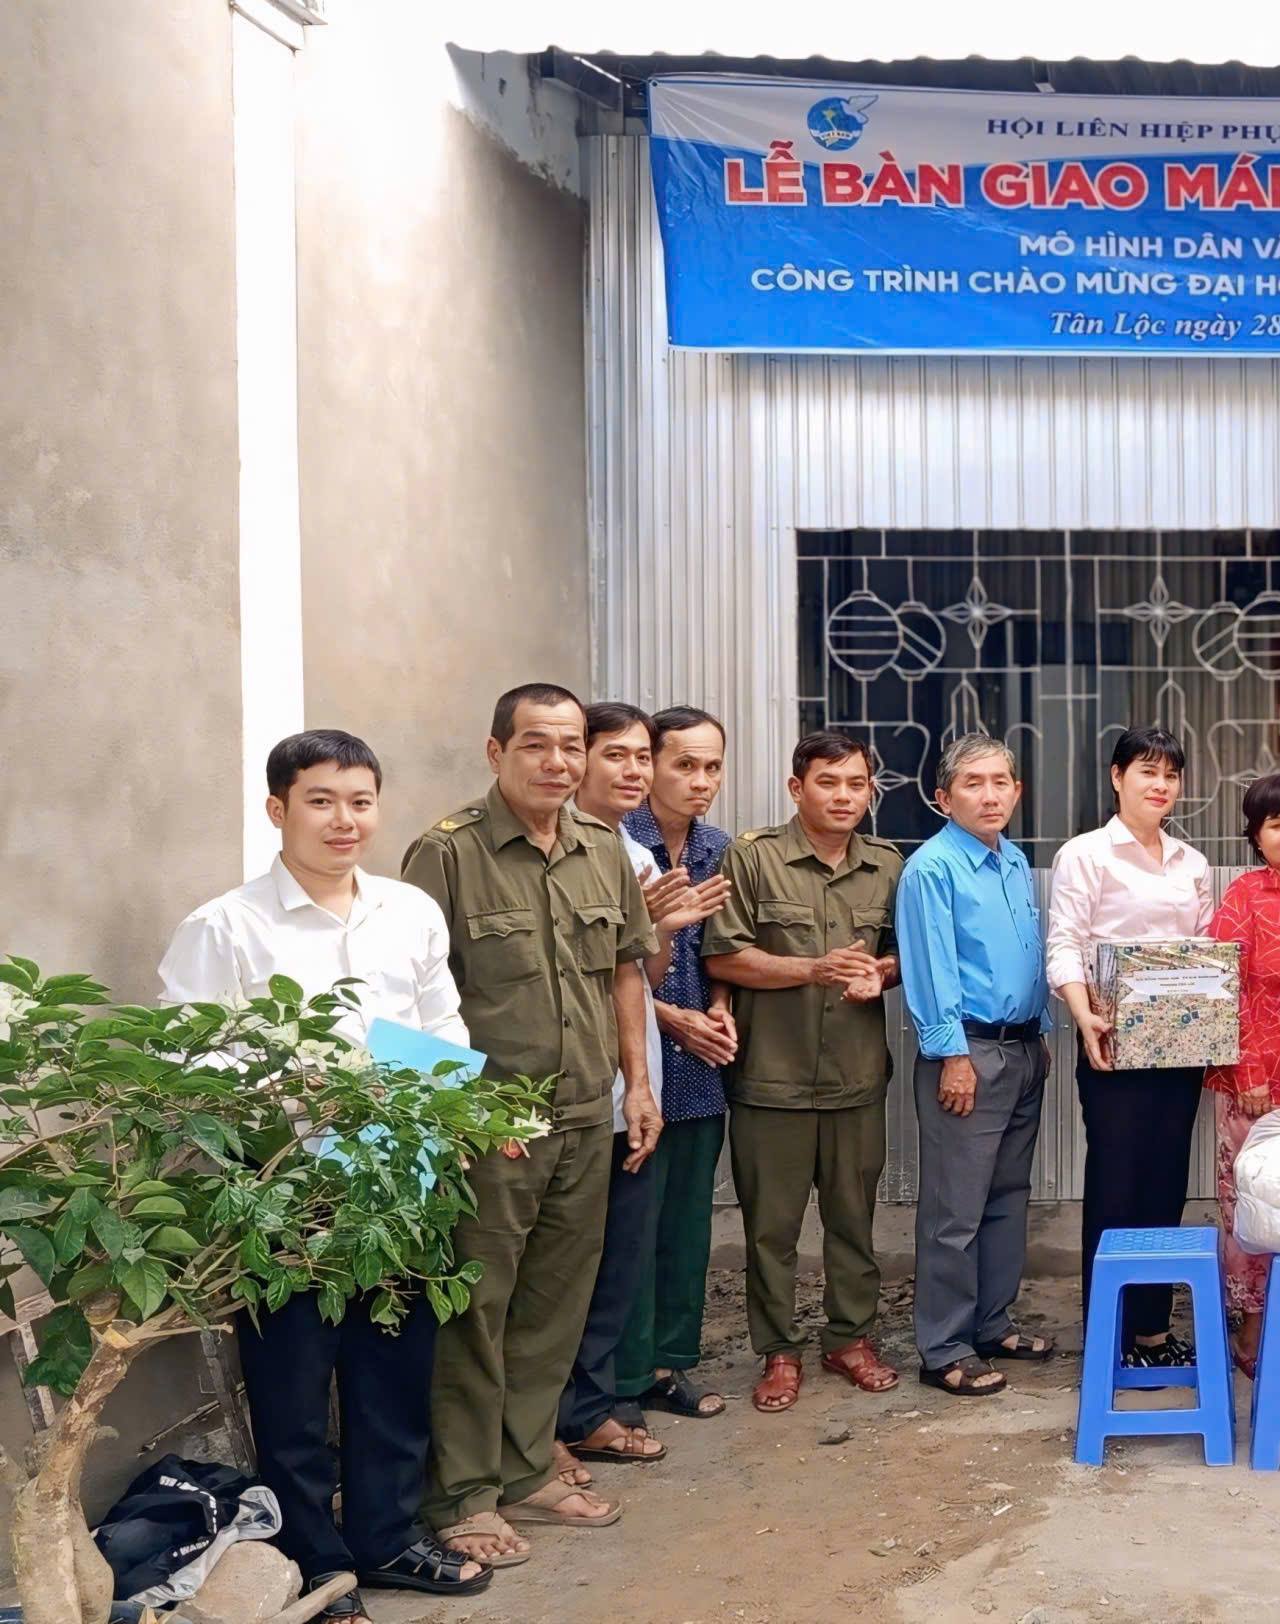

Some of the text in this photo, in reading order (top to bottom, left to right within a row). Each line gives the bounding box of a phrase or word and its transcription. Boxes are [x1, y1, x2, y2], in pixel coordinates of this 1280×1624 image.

[1056, 116, 1129, 137] LIÊN
[1140, 120, 1213, 142] HIỆP
[724, 139, 807, 206] LỄ
[820, 149, 965, 208] BÀN
[980, 161, 1149, 211] GIAO
[1019, 230, 1076, 256] MÔ
[1085, 230, 1163, 258] HÌNH
[1173, 231, 1243, 260] DÂN
[750, 262, 855, 292] CÔNG
[863, 264, 960, 293] TRÌNH
[968, 266, 1067, 295] CHÀO
[1075, 266, 1184, 296] MỪNG
[1187, 273, 1245, 303] ĐẠI
[1050, 311, 1104, 336] Tân
[1113, 312, 1167, 340] Lộc
[1174, 313, 1242, 342] ngày
